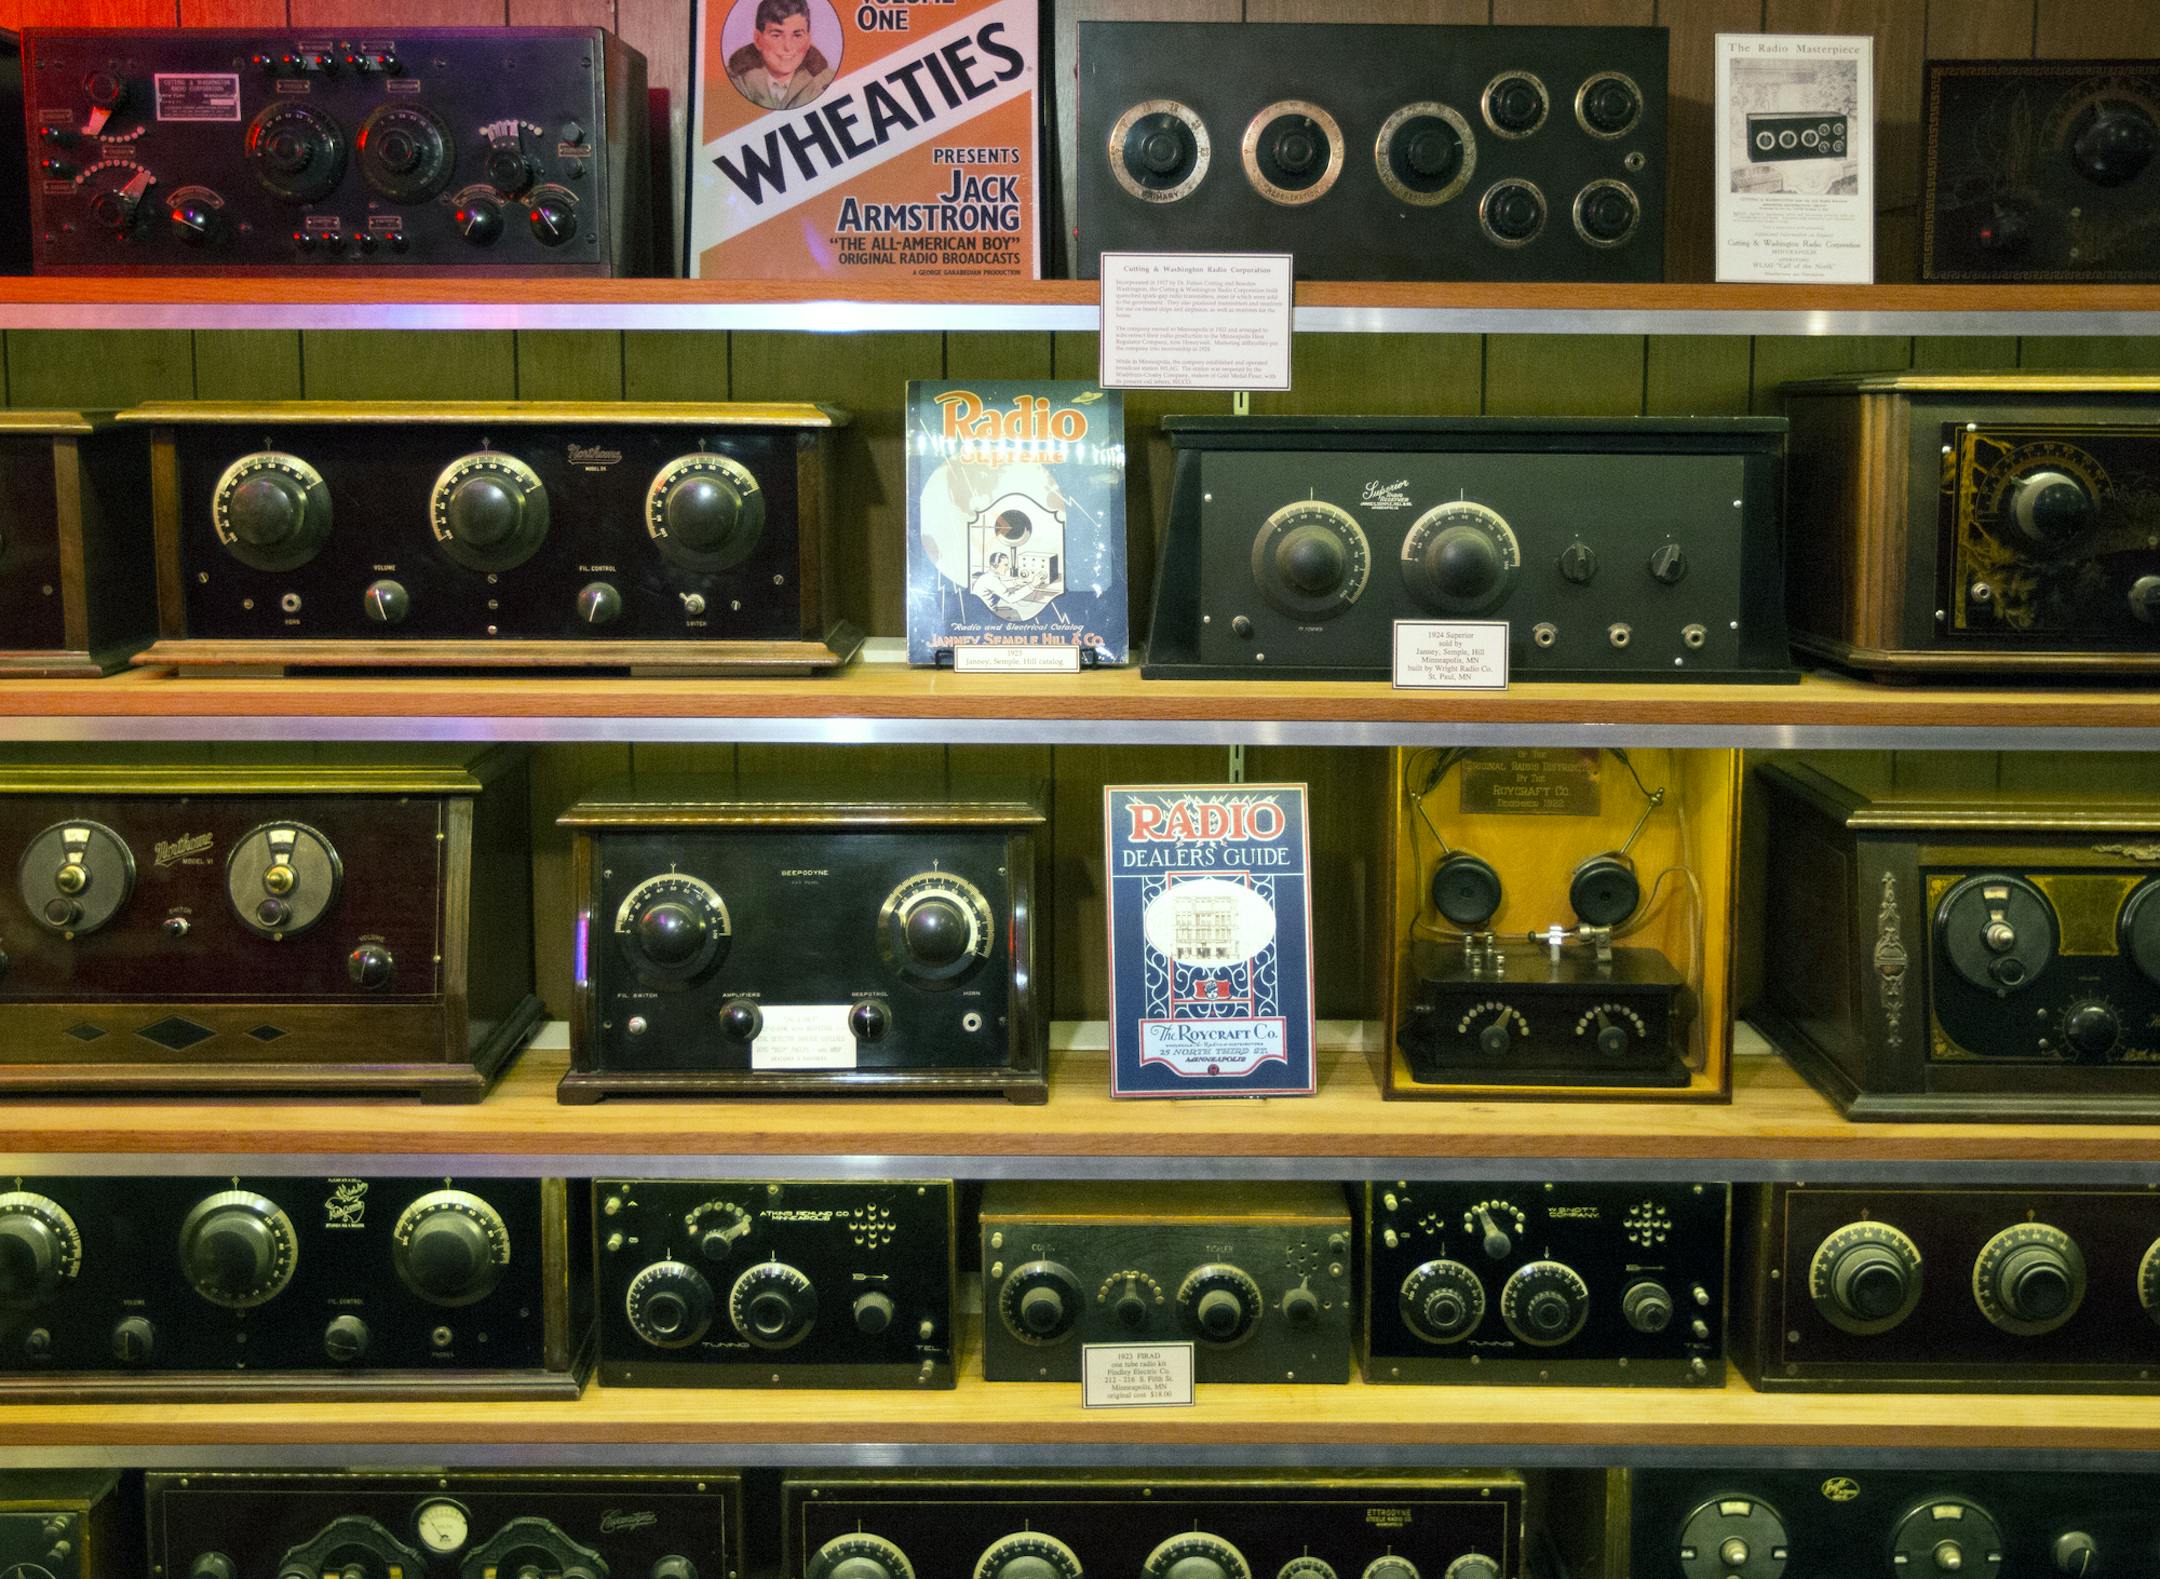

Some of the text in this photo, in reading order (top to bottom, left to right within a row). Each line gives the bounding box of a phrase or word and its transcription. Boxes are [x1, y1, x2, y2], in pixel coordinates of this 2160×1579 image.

[857, 4, 909, 32] ONE
[1728, 42, 1861, 55] The Radio Masterpiece
[712, 21, 1025, 206] WHEATIES
[933, 149, 1020, 164] PRESENTS
[940, 169, 1019, 204] JACK
[836, 198, 1020, 232] ARMSTRONG
[871, 237, 977, 251] ALL-AMERICAN
[838, 252, 1021, 265] ORIGINAL RADIO BROADCASTS
[1123, 265, 1150, 273] Cutting
[1163, 265, 1204, 274] Washington
[1230, 266, 1271, 274] Corporation
[934, 390, 1088, 442] Radio
[950, 623, 981, 632] Radio
[1050, 623, 1085, 633] Catalog
[1428, 631, 1474, 640] 1924 Superior
[1454, 640, 1463, 648] by
[1424, 665, 1433, 673] by
[1434, 664, 1458, 673] Wright
[1124, 799, 1286, 842] RADIO
[1122, 847, 1291, 868] DEALERS GUIDE
[1150, 1024, 1178, 1042] The
[1178, 1024, 1251, 1044] ROYCRAFT
[1173, 1048, 1212, 1056] NORTH
[1215, 1047, 1250, 1055] THIRD
